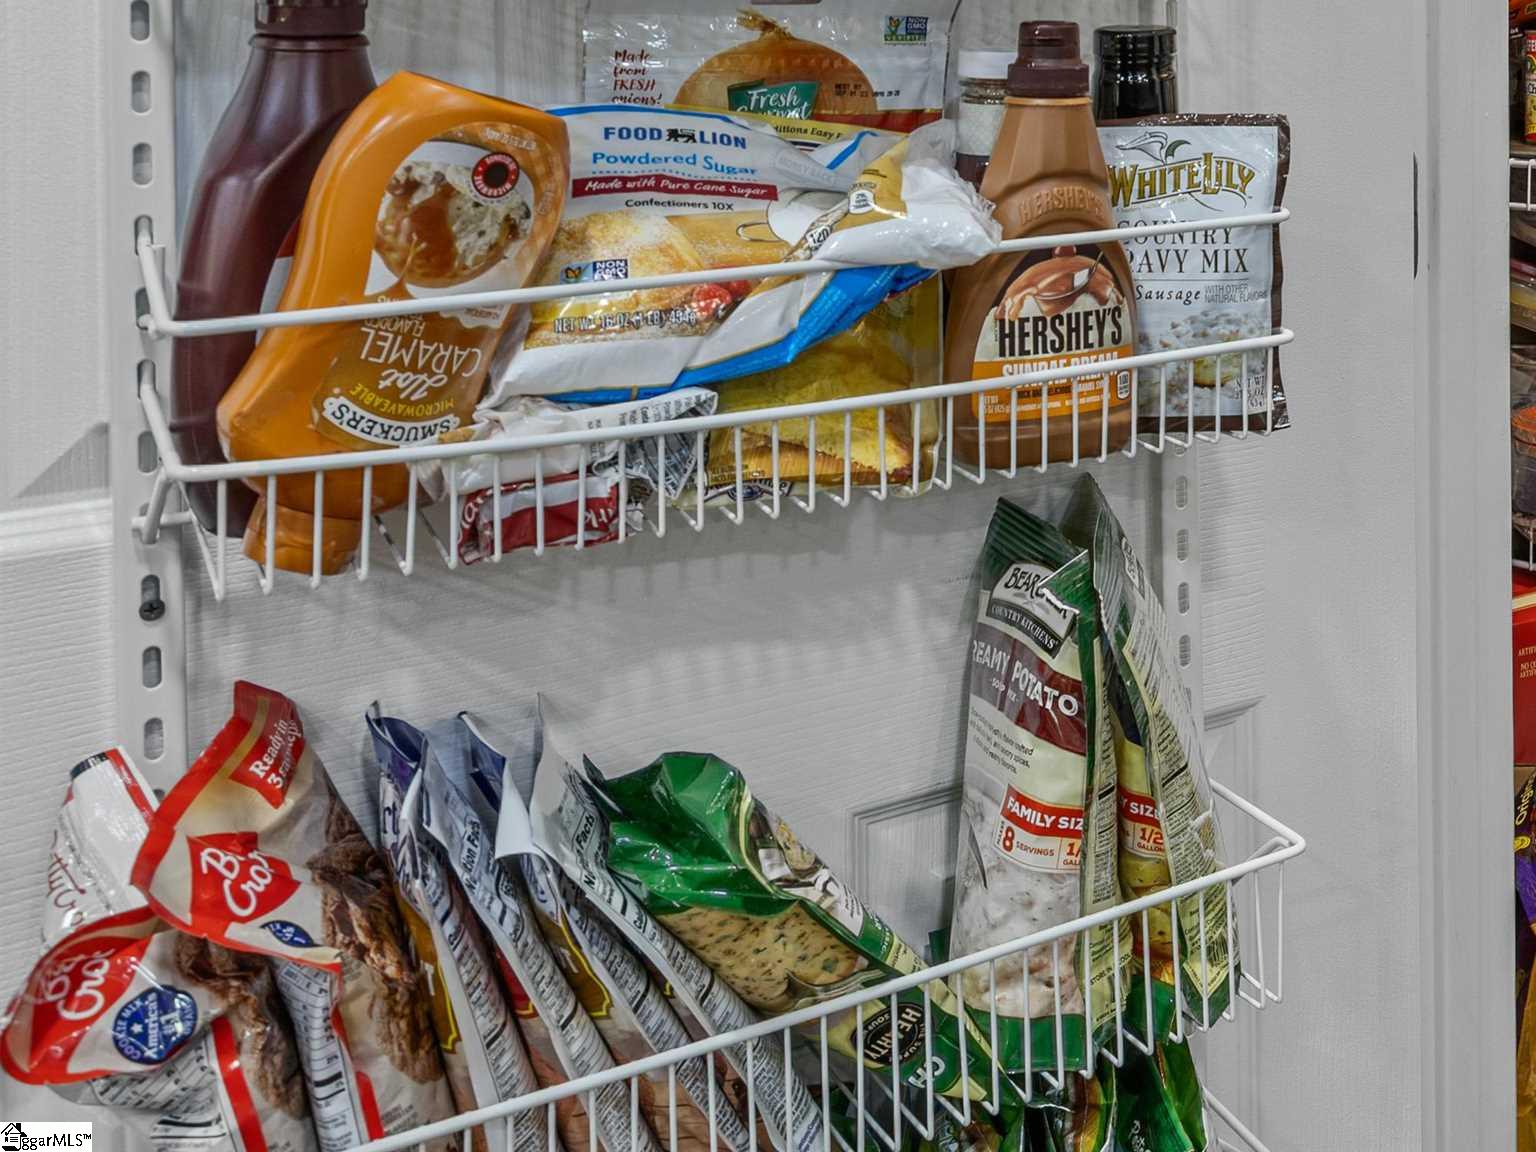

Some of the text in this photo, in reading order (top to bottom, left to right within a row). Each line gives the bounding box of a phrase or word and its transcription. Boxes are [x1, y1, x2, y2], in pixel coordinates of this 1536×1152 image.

[613, 49, 650, 64] Made
[613, 65, 647, 77] from
[611, 93, 663, 106] onions!
[748, 84, 800, 108] Fresh
[603, 126, 747, 150] FOOD LION
[810, 127, 834, 140] Easy
[591, 151, 760, 178] Powdered Sugar
[584, 177, 768, 200] Made with Pure Cane Sugar
[1107, 151, 1257, 208] WHITE LILY
[625, 197, 735, 213] Confectioners 10X
[596, 260, 627, 271] NON
[1199, 247, 1250, 274] MIX
[1135, 284, 1201, 305] Sausage
[999, 305, 1123, 358] HERSHEY'S
[359, 326, 482, 377] CARAMEL
[378, 367, 450, 400] Hot
[349, 382, 456, 417] MICROWAVEABLE
[330, 402, 455, 444] SMUCKER'S
[1011, 664, 1080, 719] POTATO
[267, 773, 284, 789] 3
[1006, 800, 1056, 830] FAMILY
[1002, 825, 1055, 857] 8 SERVINGS
[1138, 825, 1164, 845] 1/2
